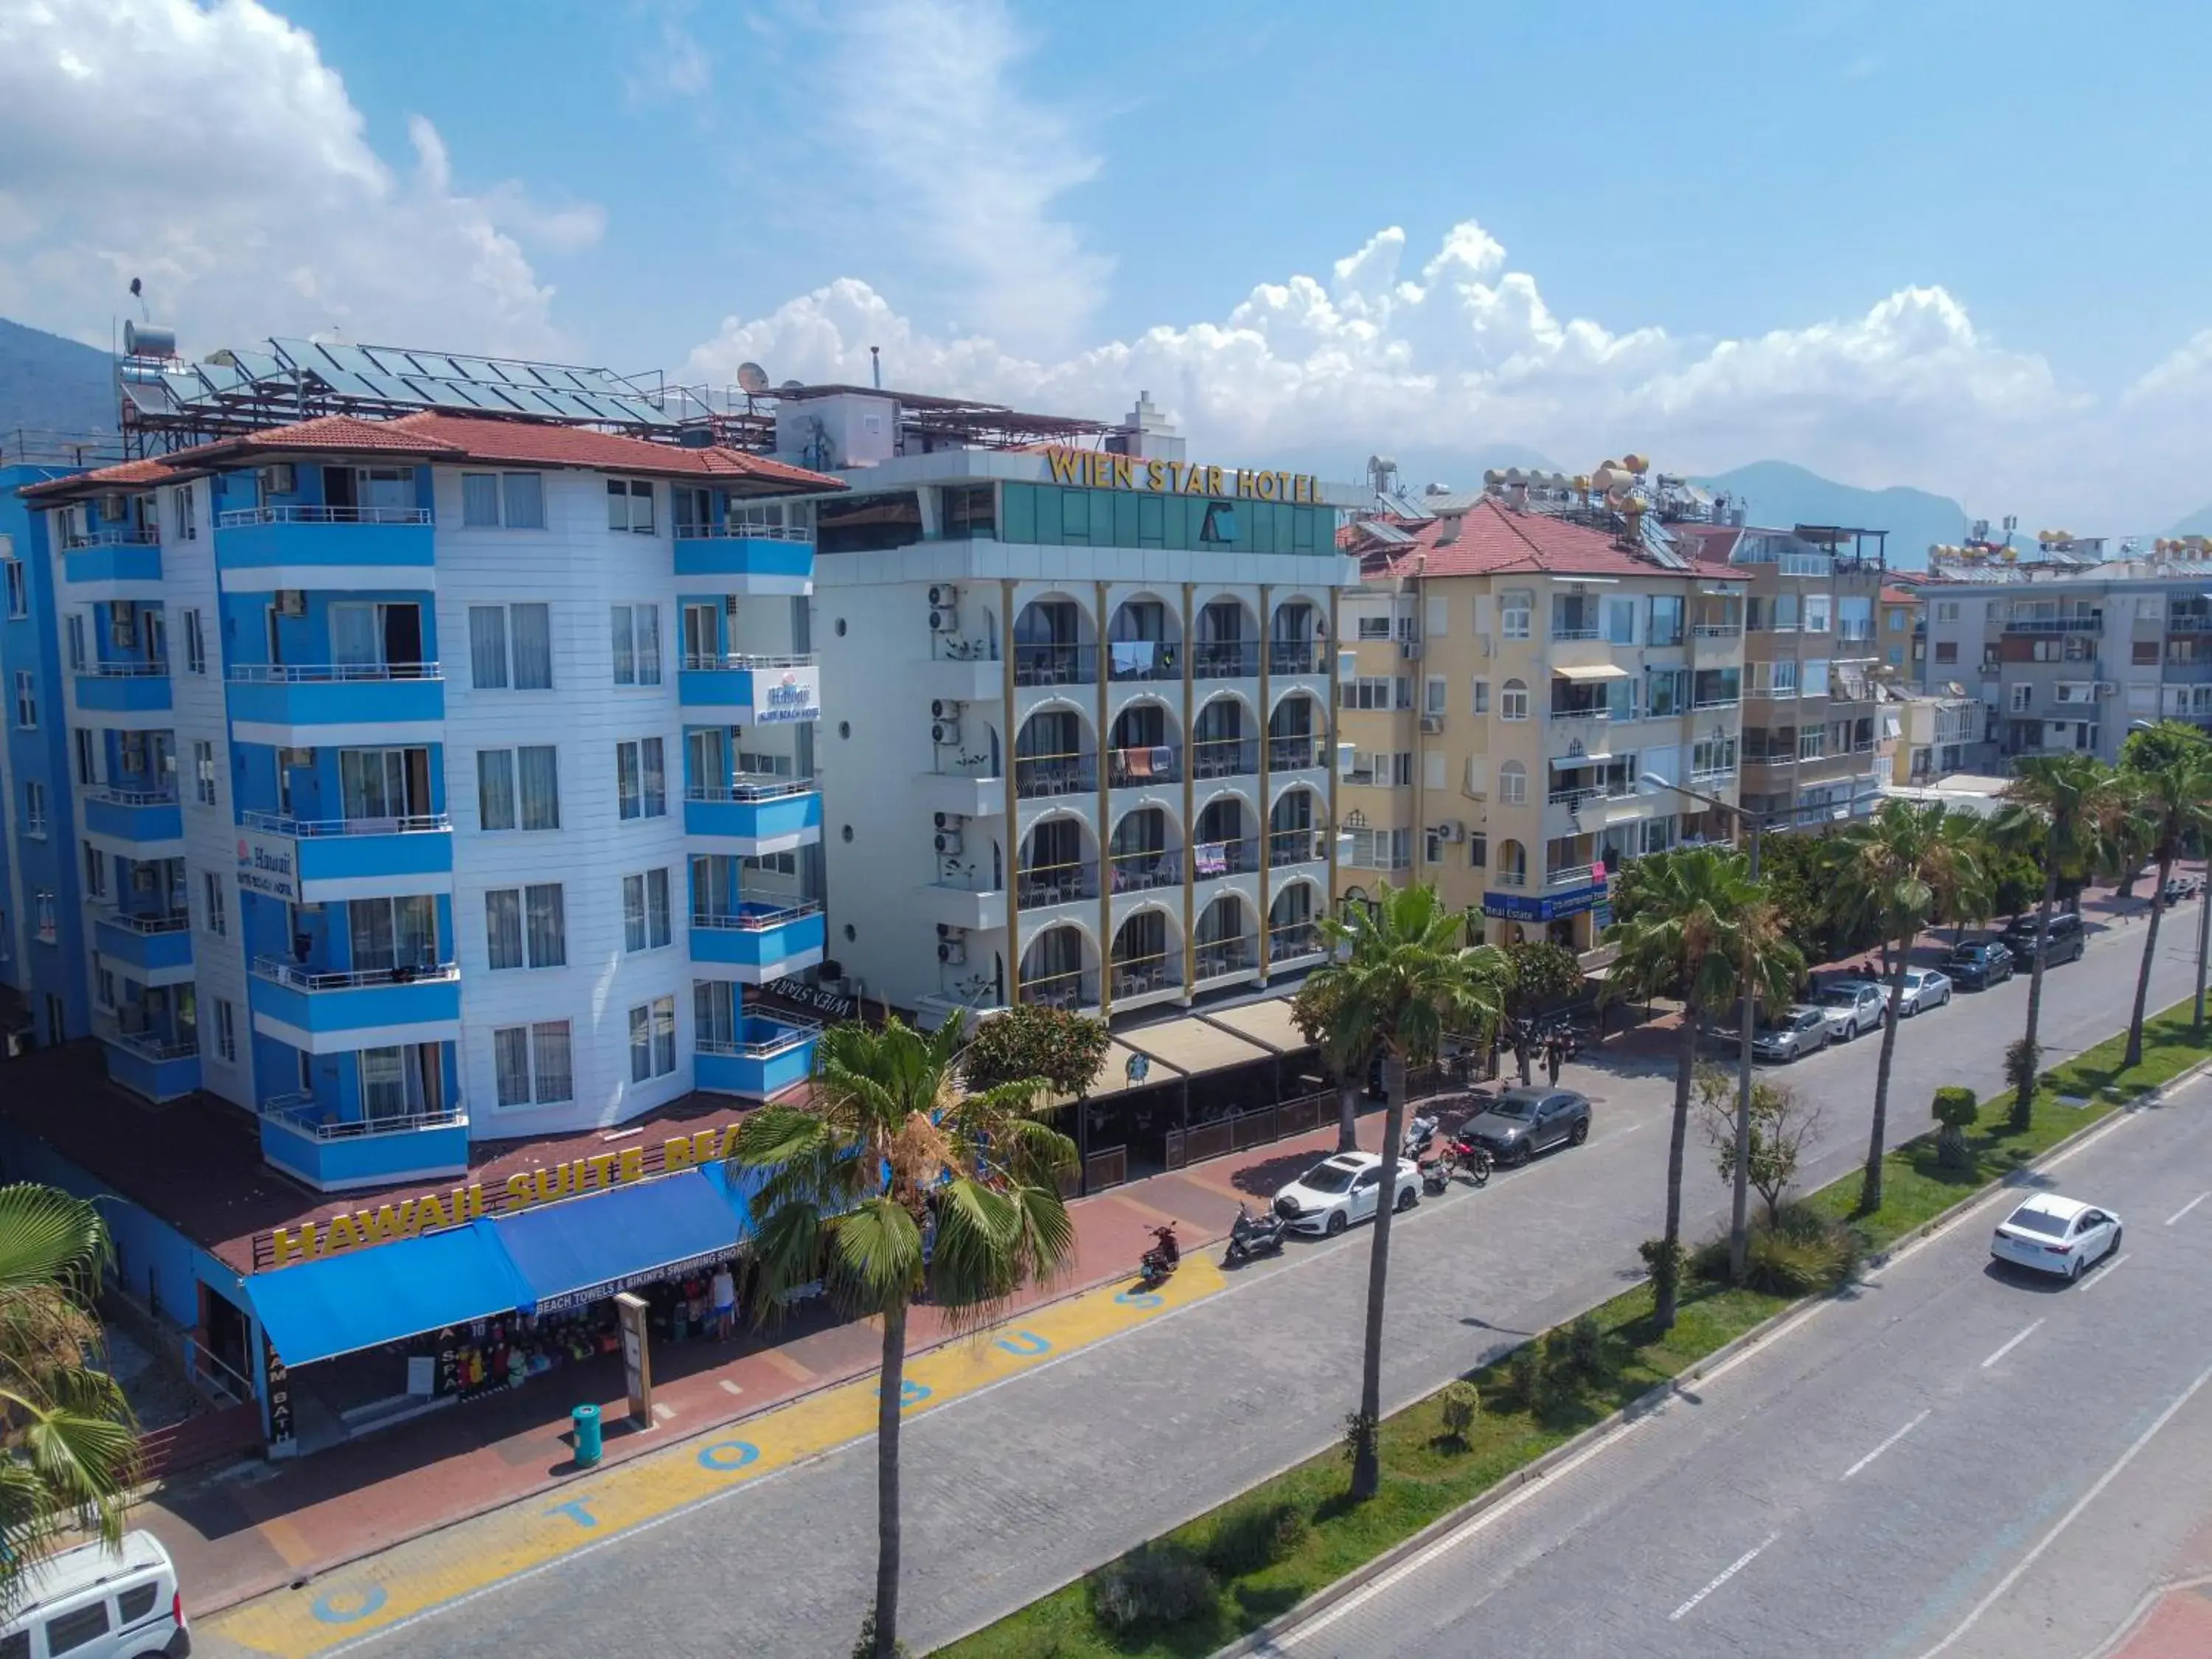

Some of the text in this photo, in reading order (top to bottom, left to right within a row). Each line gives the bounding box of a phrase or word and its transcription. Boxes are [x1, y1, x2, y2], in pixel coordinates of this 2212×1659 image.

[1047, 450, 1324, 504] WIEN STAR HOTEL
[272, 1183, 483, 1267] HAWAII
[506, 1147, 643, 1209] SUITE
[537, 1294, 571, 1315] BEACH
[574, 1284, 614, 1305] TOWELS
